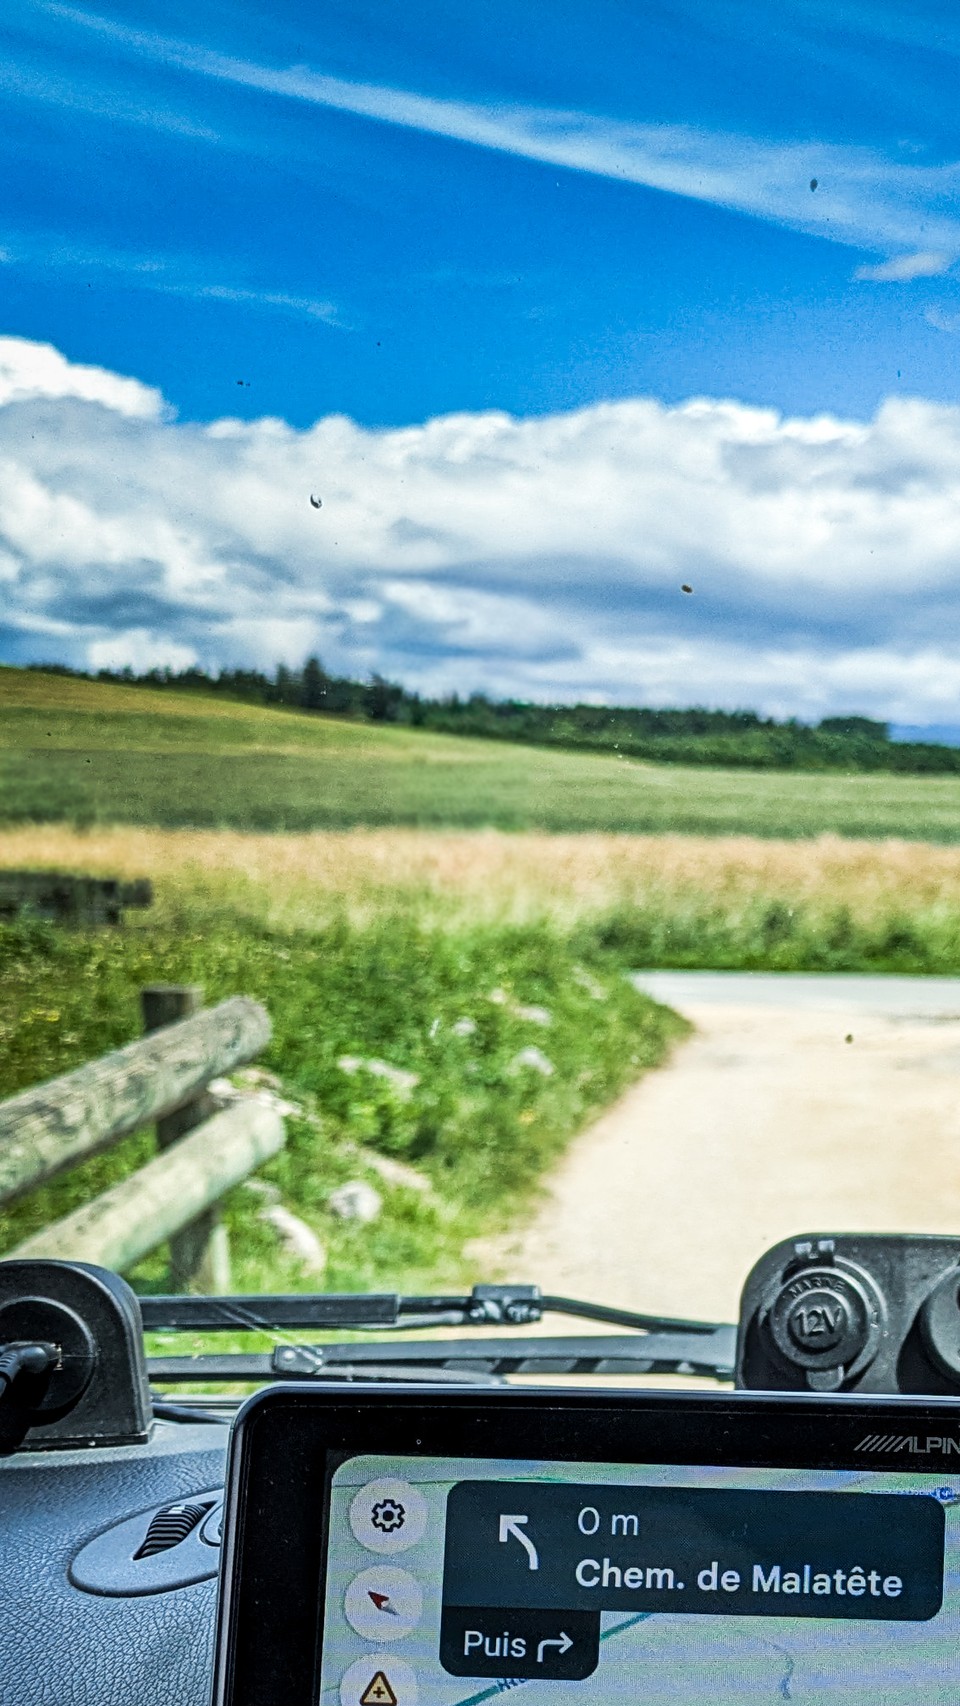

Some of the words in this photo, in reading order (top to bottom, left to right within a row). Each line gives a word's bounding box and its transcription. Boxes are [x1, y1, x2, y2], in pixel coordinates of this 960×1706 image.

[795, 1303, 842, 1337] 12V
[578, 1507, 600, 1536] 0
[611, 1512, 639, 1536] m
[575, 1558, 685, 1591] Chem.
[697, 1559, 741, 1592] de
[751, 1565, 903, 1597] Malatête
[463, 1632, 526, 1658] Puis
